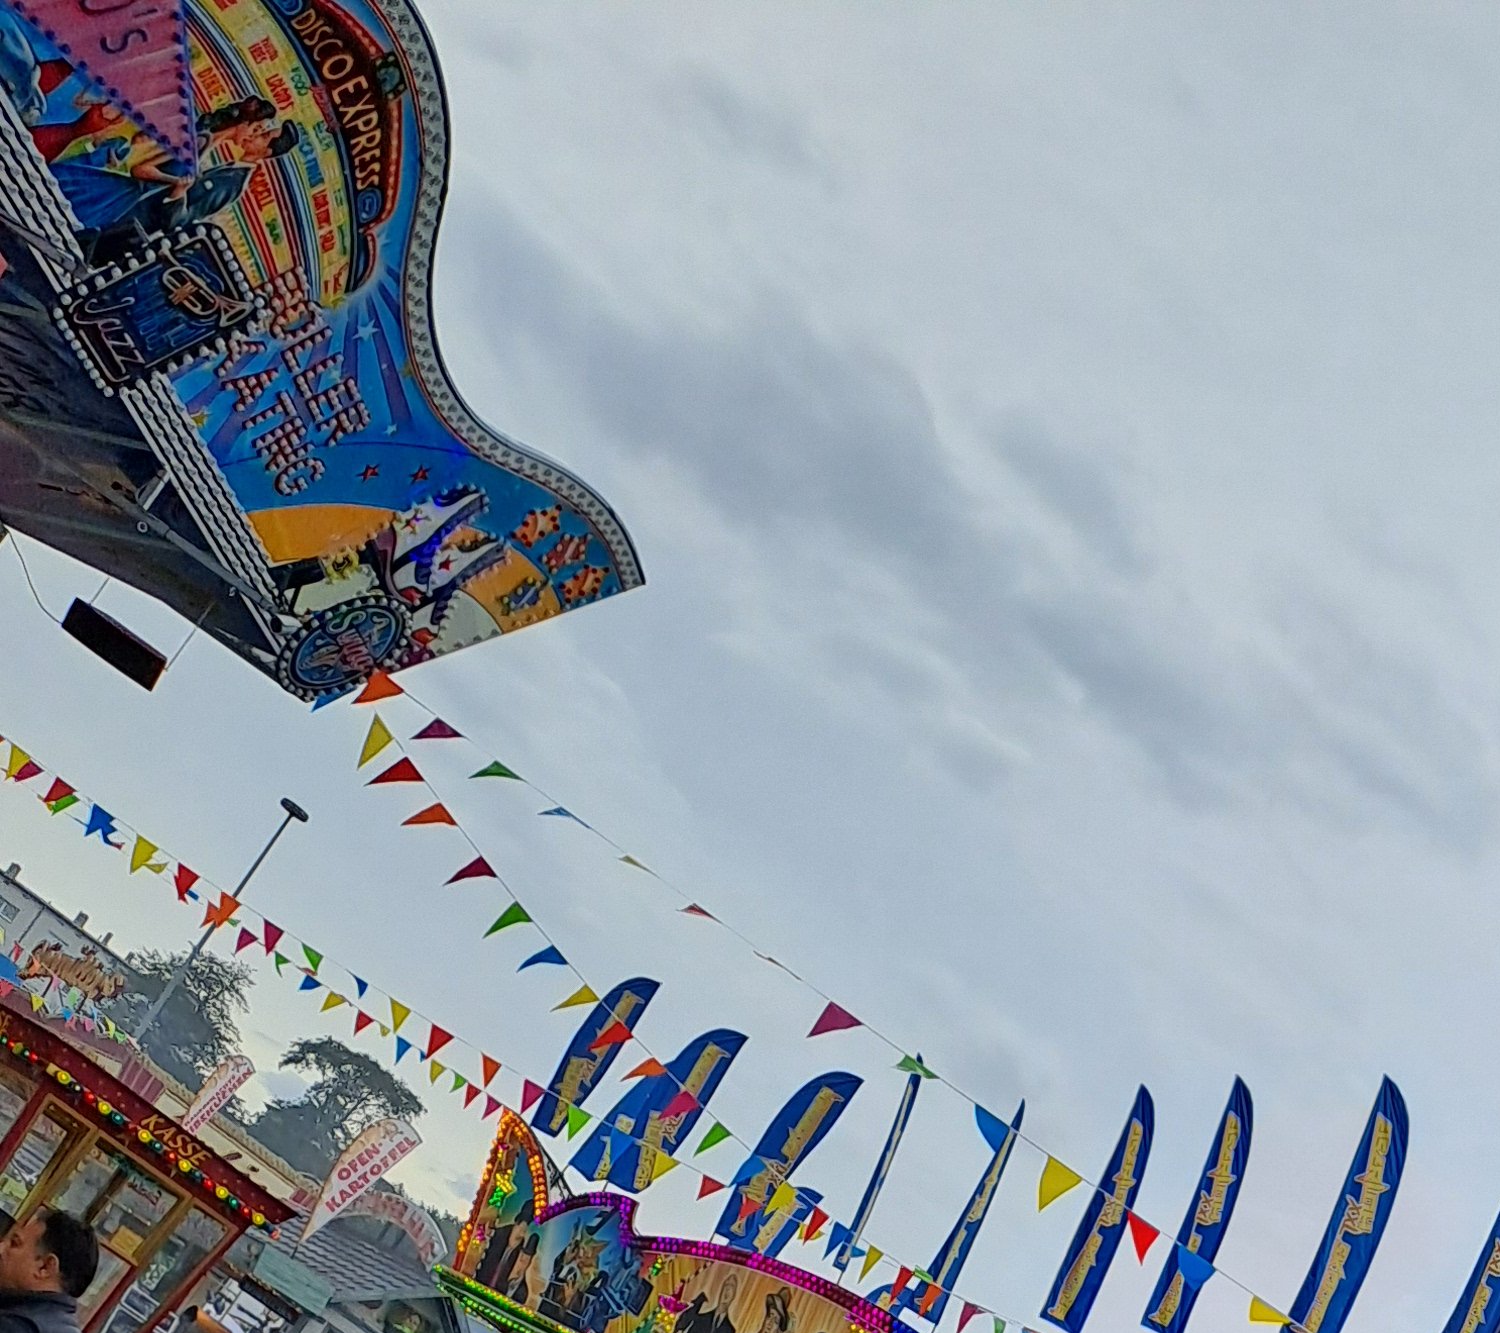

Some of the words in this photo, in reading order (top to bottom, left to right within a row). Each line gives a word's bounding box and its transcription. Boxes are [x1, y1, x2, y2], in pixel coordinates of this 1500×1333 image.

[291, 7, 354, 79] DISCO
[331, 75, 384, 190] EXPRESS
[217, 338, 324, 497] KATING
[255, 265, 372, 447] ROLLER
[141, 1115, 212, 1165] KASSE
[325, 1137, 418, 1213] KARTOFFEL
